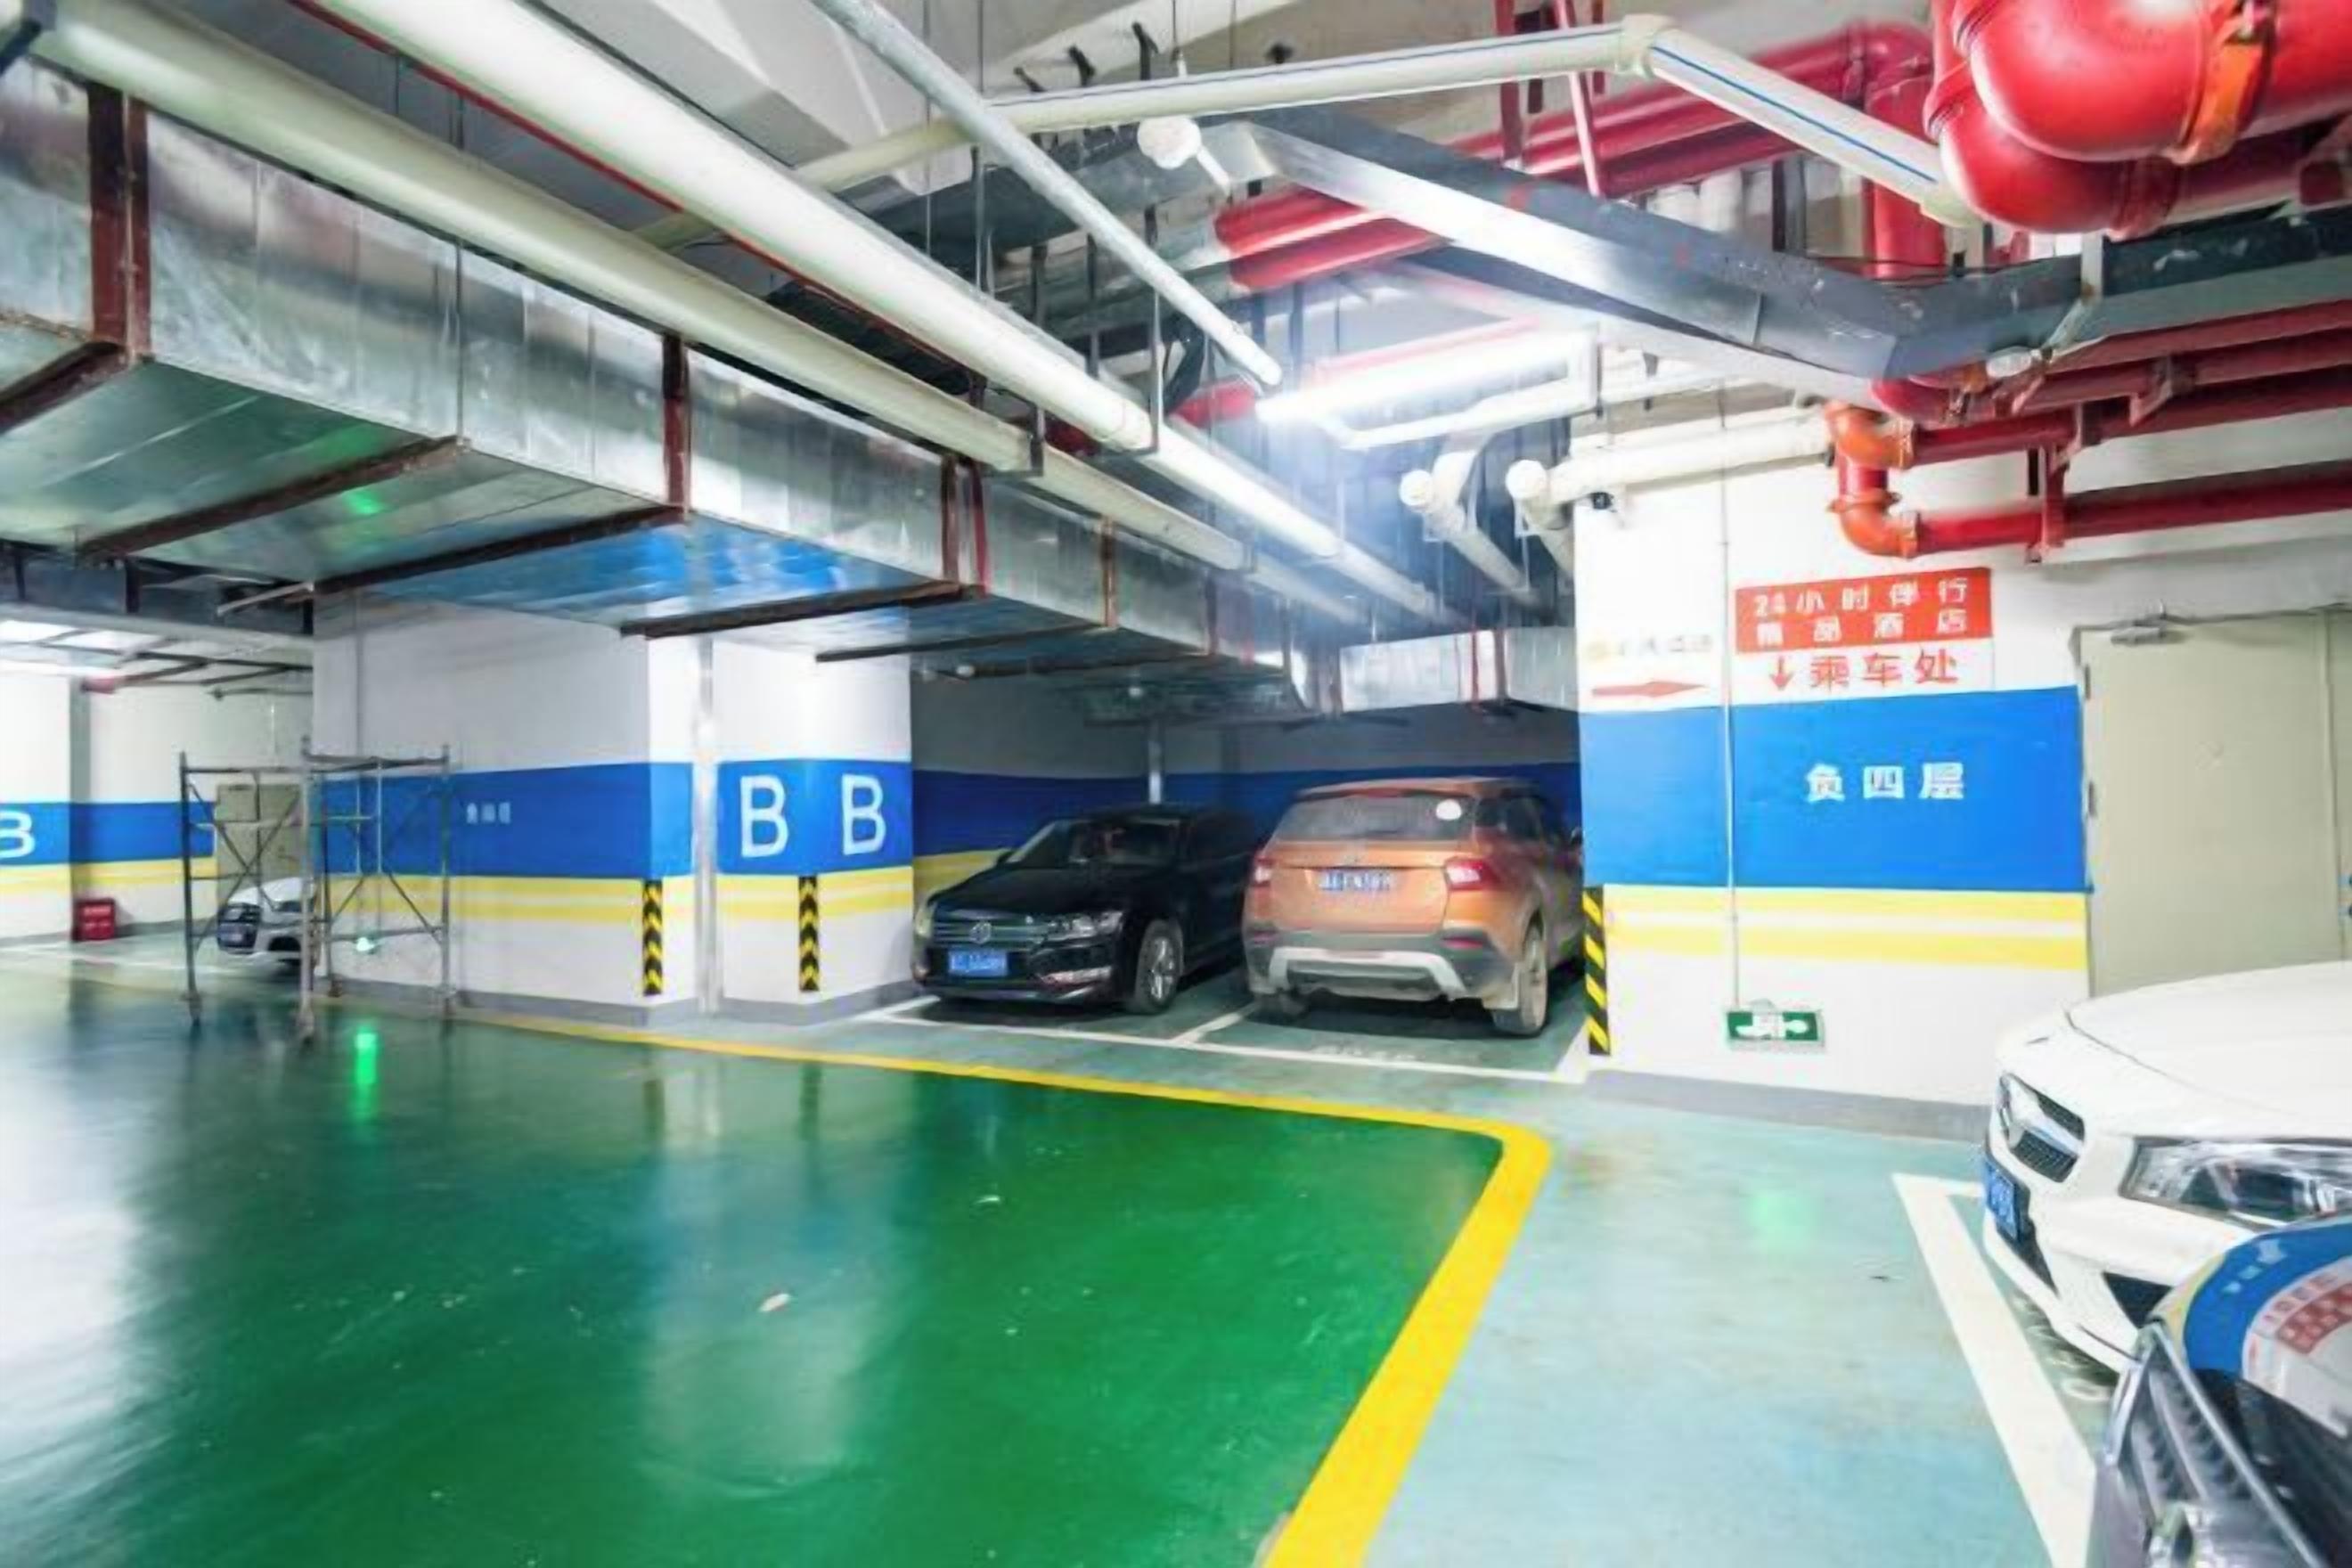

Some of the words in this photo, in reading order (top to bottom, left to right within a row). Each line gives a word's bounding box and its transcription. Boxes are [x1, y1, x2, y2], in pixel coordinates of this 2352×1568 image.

[1810, 648, 1959, 690] 乘车处
[841, 773, 886, 855] B
[1806, 763, 1964, 804] 负四层
[740, 774, 788, 858] B
